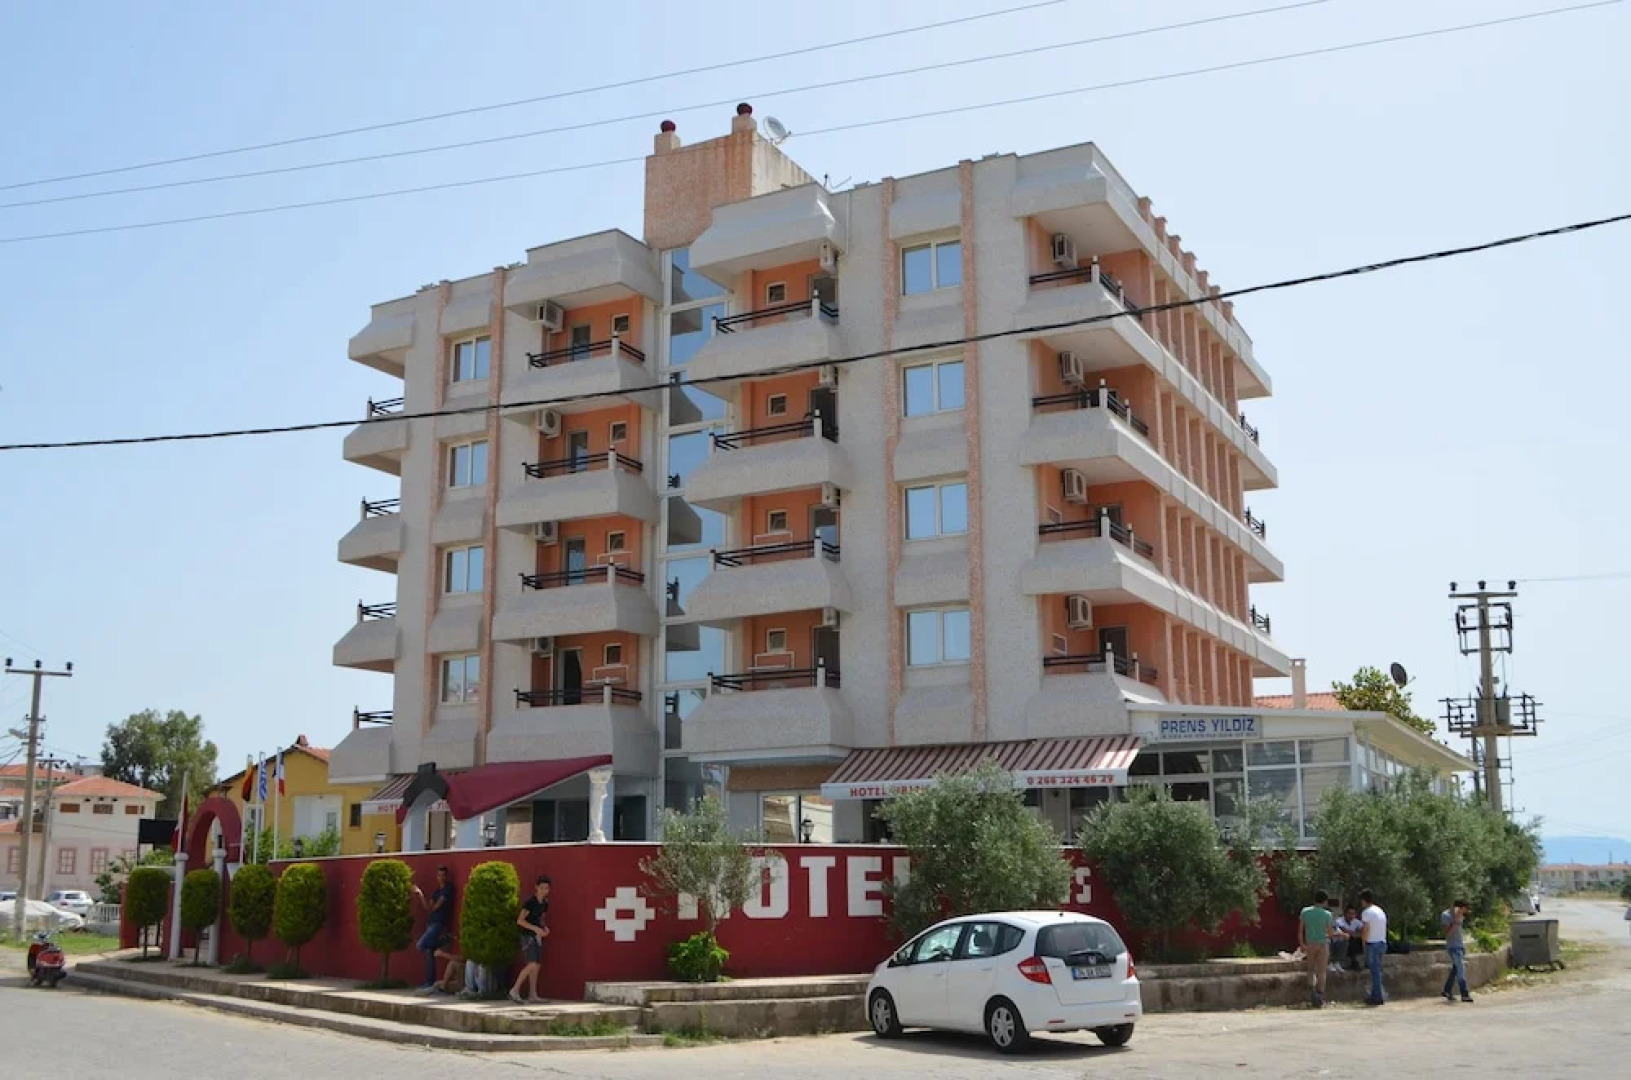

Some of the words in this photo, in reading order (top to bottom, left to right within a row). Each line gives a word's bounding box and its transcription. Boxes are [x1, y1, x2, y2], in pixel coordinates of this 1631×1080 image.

[1161, 719, 1206, 733] PRENS
[1211, 717, 1255, 732] YILDIZ
[850, 785, 887, 797] HOTEL
